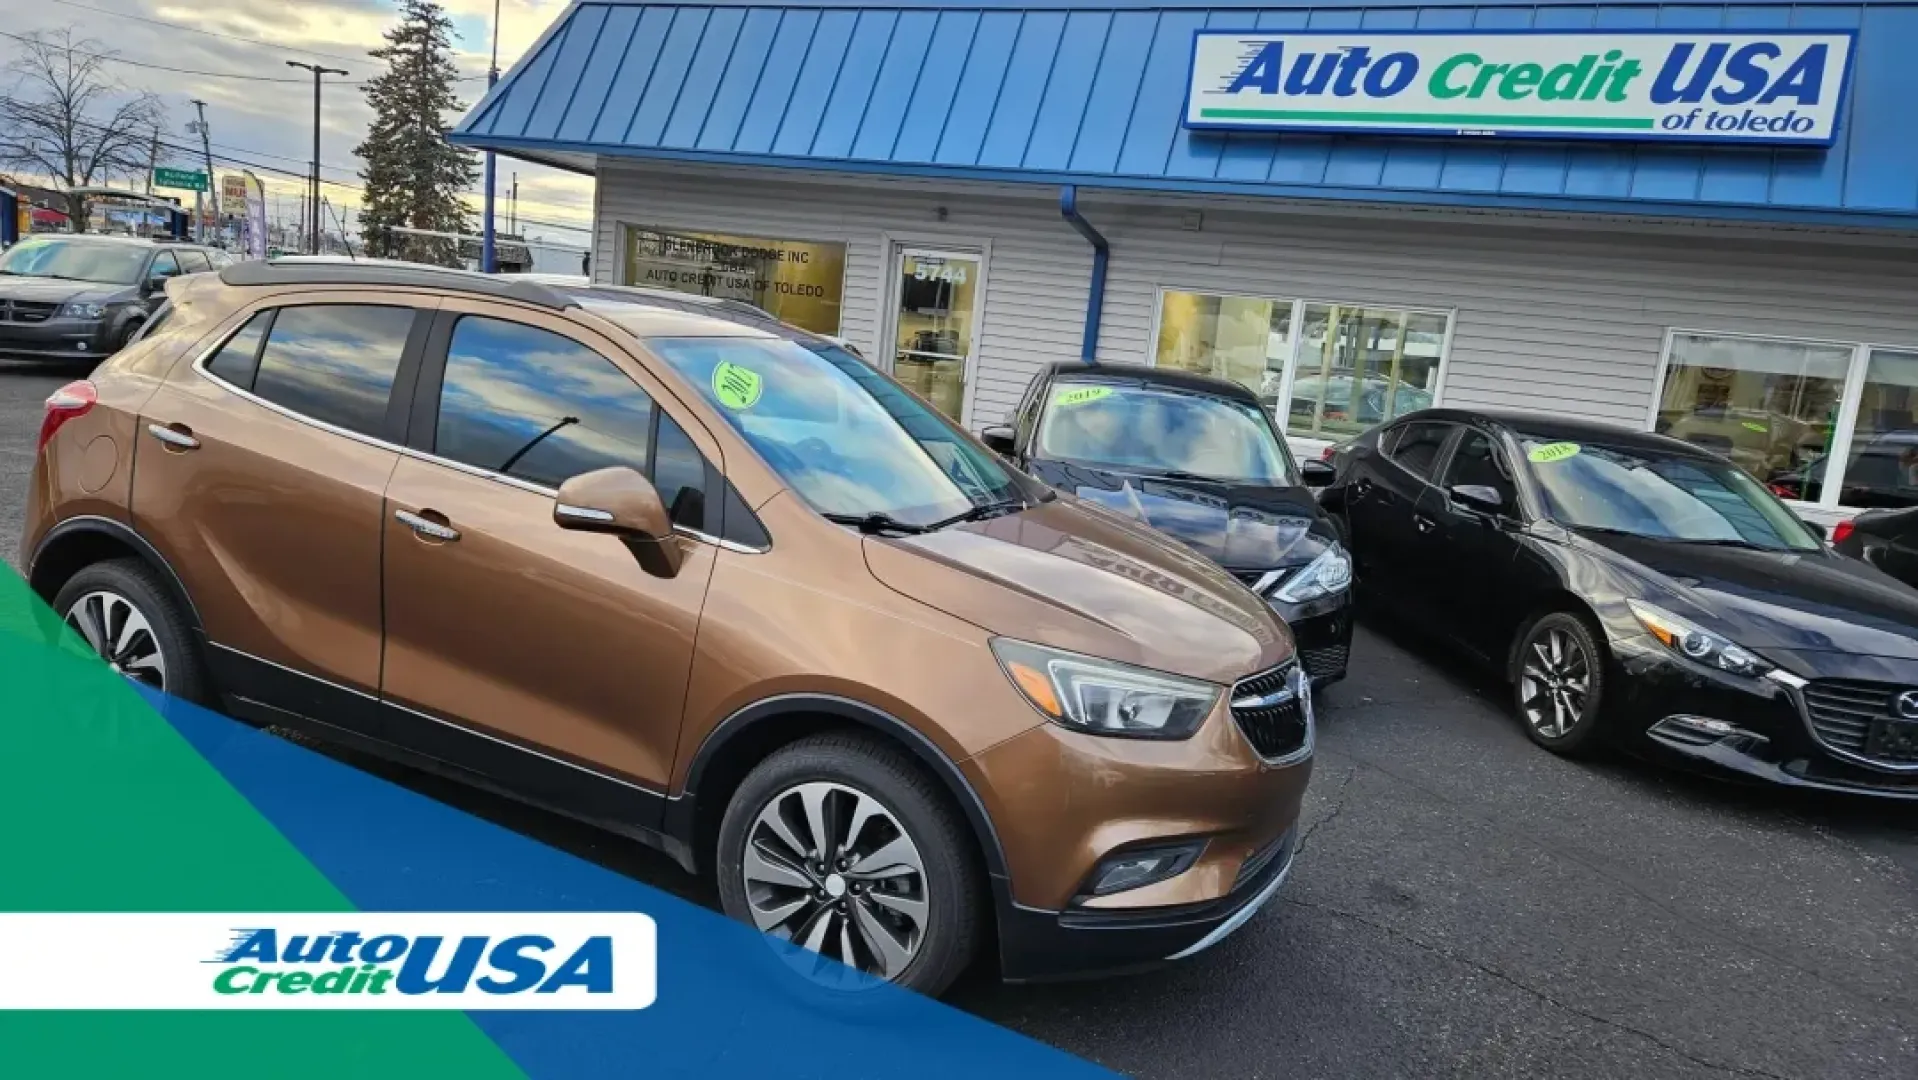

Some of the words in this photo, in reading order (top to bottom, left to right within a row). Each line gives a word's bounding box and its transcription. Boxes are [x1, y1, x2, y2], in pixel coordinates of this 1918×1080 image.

[1220, 40, 1420, 97] Auto
[1427, 48, 1642, 102] Credit
[1649, 42, 1829, 106] USA
[1661, 107, 1699, 133] of
[1703, 107, 1814, 133] toledo
[743, 247, 784, 262] DODGE
[788, 251, 809, 264] INC
[646, 270, 677, 283] AUTO
[681, 272, 721, 286] CREDIT
[727, 276, 750, 290] USA
[755, 280, 769, 292] OF
[774, 282, 825, 298] TOLEDO
[915, 263, 966, 284] 5744
